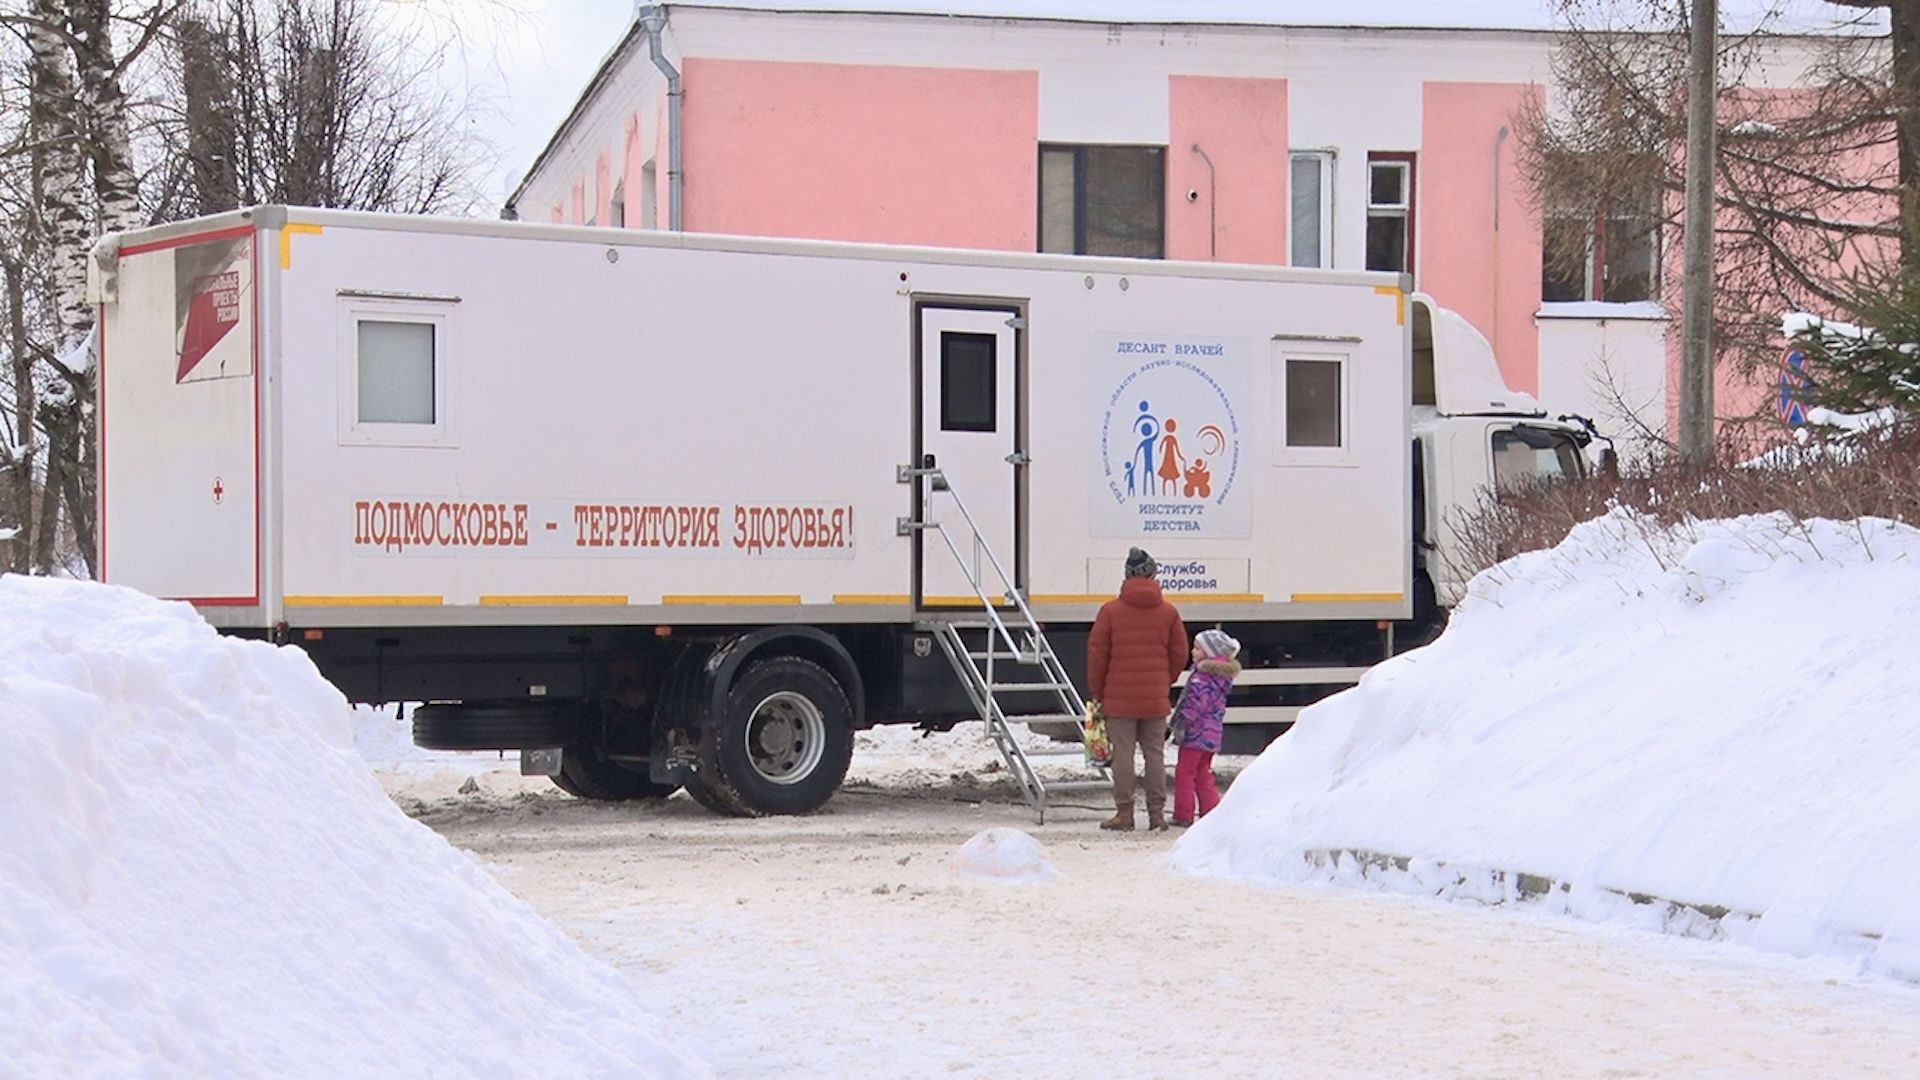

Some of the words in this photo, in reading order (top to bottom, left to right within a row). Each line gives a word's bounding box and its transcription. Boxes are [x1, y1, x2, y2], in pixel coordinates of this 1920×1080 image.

[1117, 342, 1167, 354] ДЕСАНТ
[1174, 343, 1223, 356] ВРАЧЕЙ
[1110, 371, 1137, 406] области
[1139, 503, 1204, 515] ИНСТИТУТ
[355, 500, 528, 553] ПОДМОСКОВЬЕ
[546, 522, 557, 530] -
[574, 504, 720, 548] ТЕРРИТОРИЯ
[733, 504, 853, 555] ЗДОРОВЬЯ!
[1143, 520, 1201, 531] ДЕТСТВА
[1155, 562, 1206, 577] Служба
[1157, 578, 1217, 591] доровья
